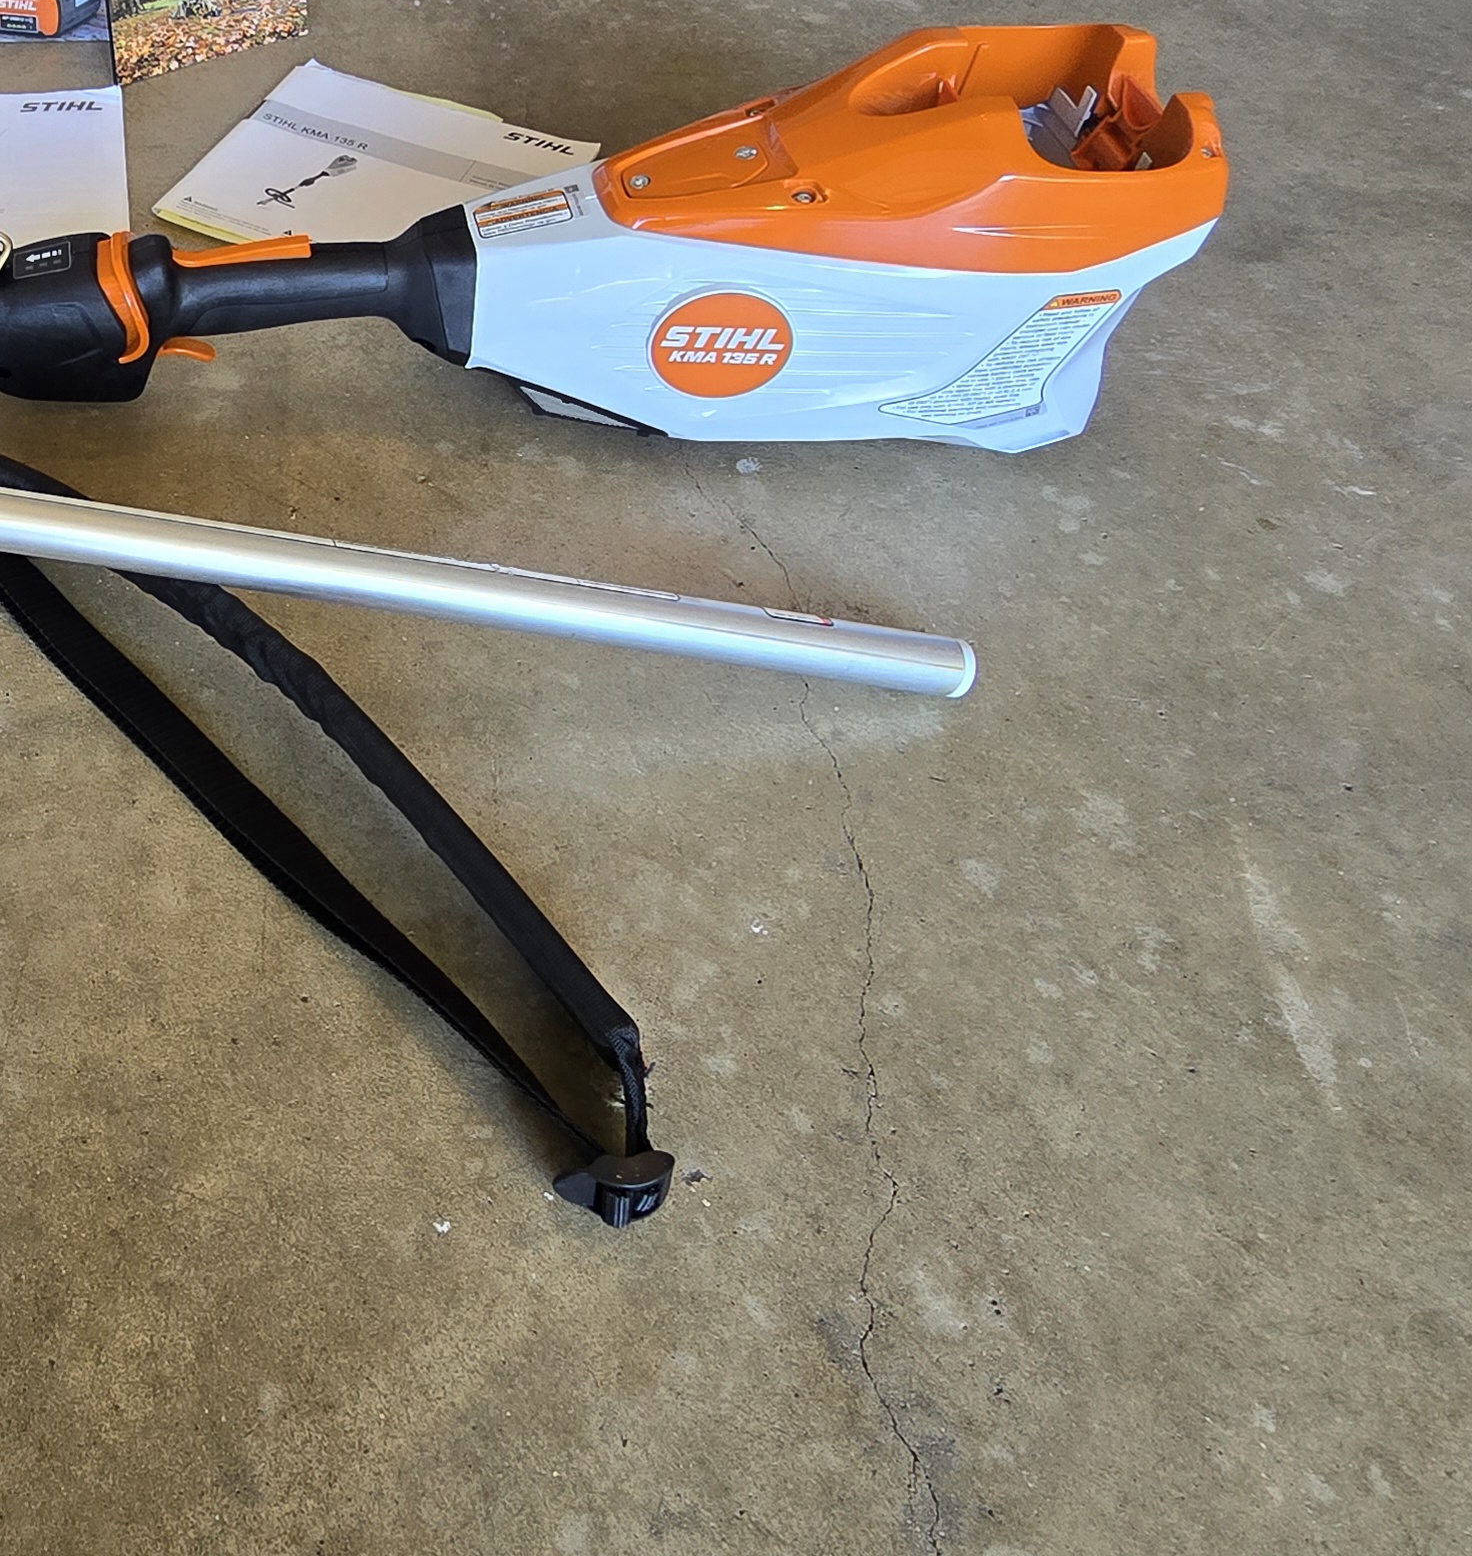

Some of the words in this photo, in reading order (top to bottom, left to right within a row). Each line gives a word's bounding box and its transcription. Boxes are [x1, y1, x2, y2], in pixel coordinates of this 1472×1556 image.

[19, 100, 104, 113] STIHL
[262, 112, 300, 135] STIHL
[300, 124, 330, 141] KMA
[333, 134, 356, 148] 135
[357, 141, 369, 150] R
[502, 130, 576, 157] STIHL
[1061, 293, 1118, 306] WARNING
[659, 325, 786, 351] STIHL
[668, 350, 718, 364] KMA
[721, 351, 760, 365] 135
[759, 353, 779, 366] R
